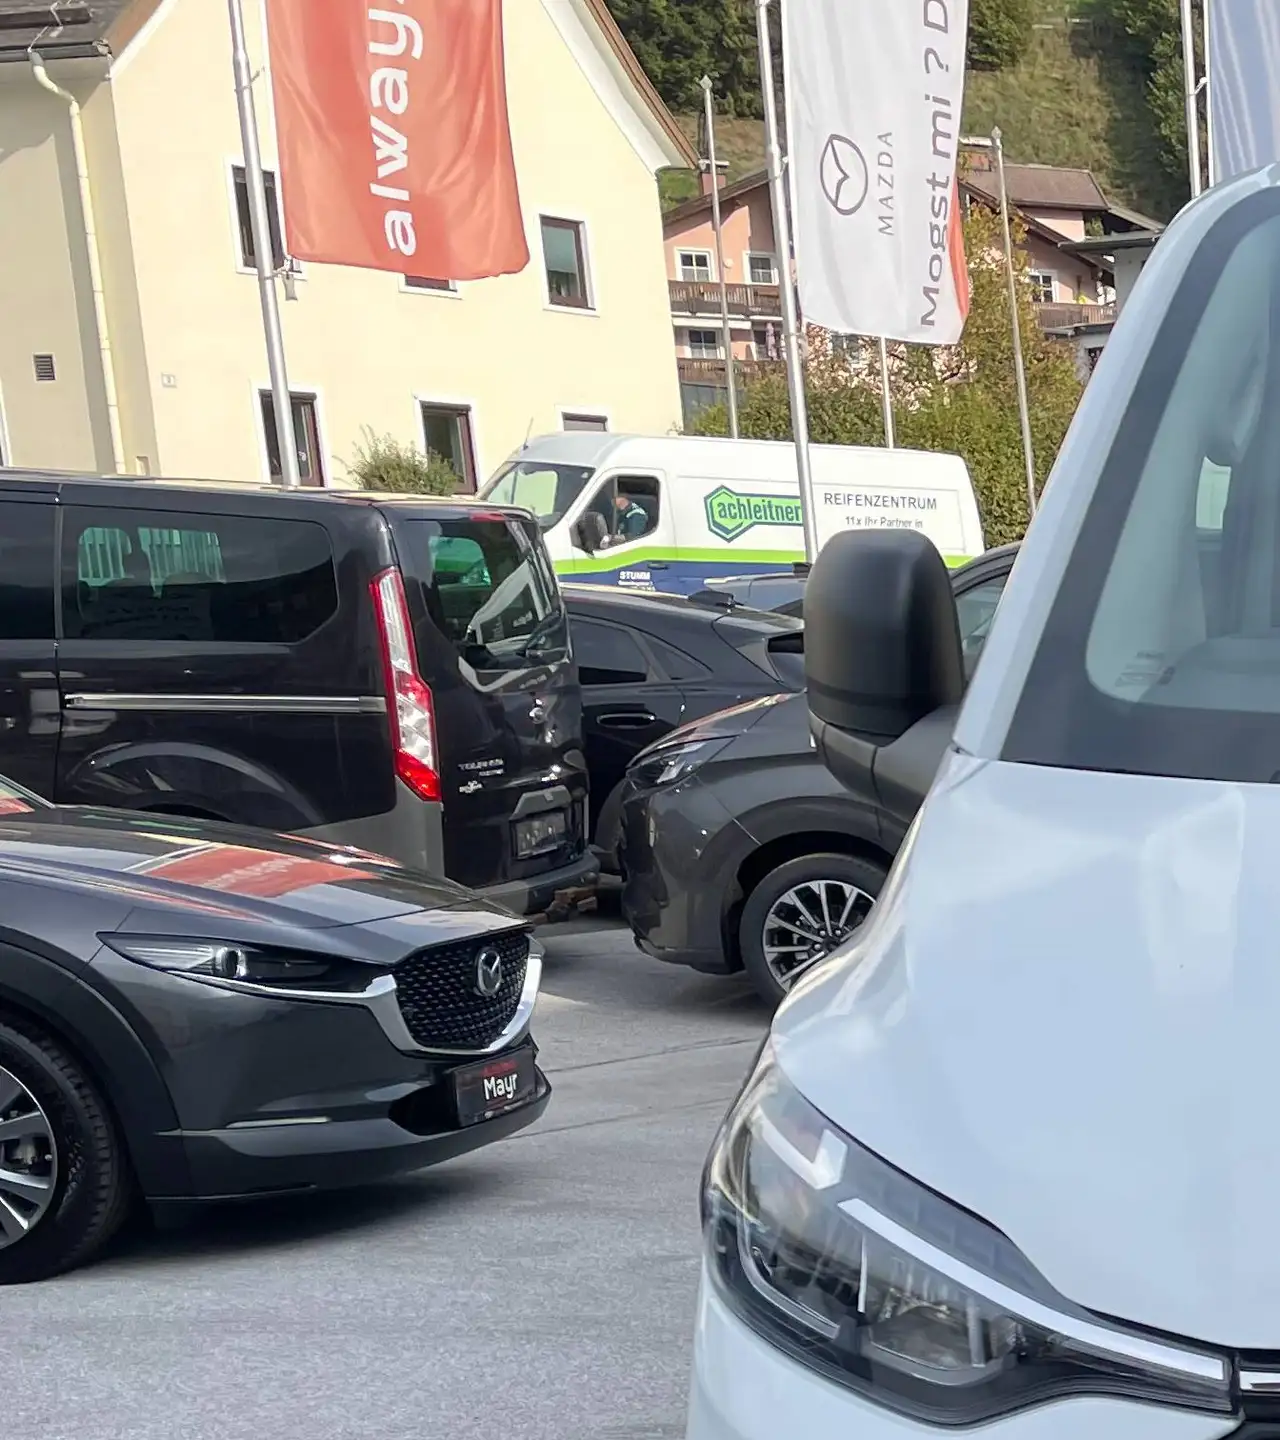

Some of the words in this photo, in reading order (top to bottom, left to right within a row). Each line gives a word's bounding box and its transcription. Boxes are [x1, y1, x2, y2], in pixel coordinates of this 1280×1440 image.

[924, 47, 949, 74] ?
[368, 0, 423, 256] alway
[924, 94, 952, 159] mi
[877, 131, 895, 236] MAZDA
[920, 172, 950, 326] Mogst
[717, 498, 801, 522] achleitner
[824, 492, 938, 510] REIFENZENTRUM
[483, 1073, 518, 1100] Mayr
